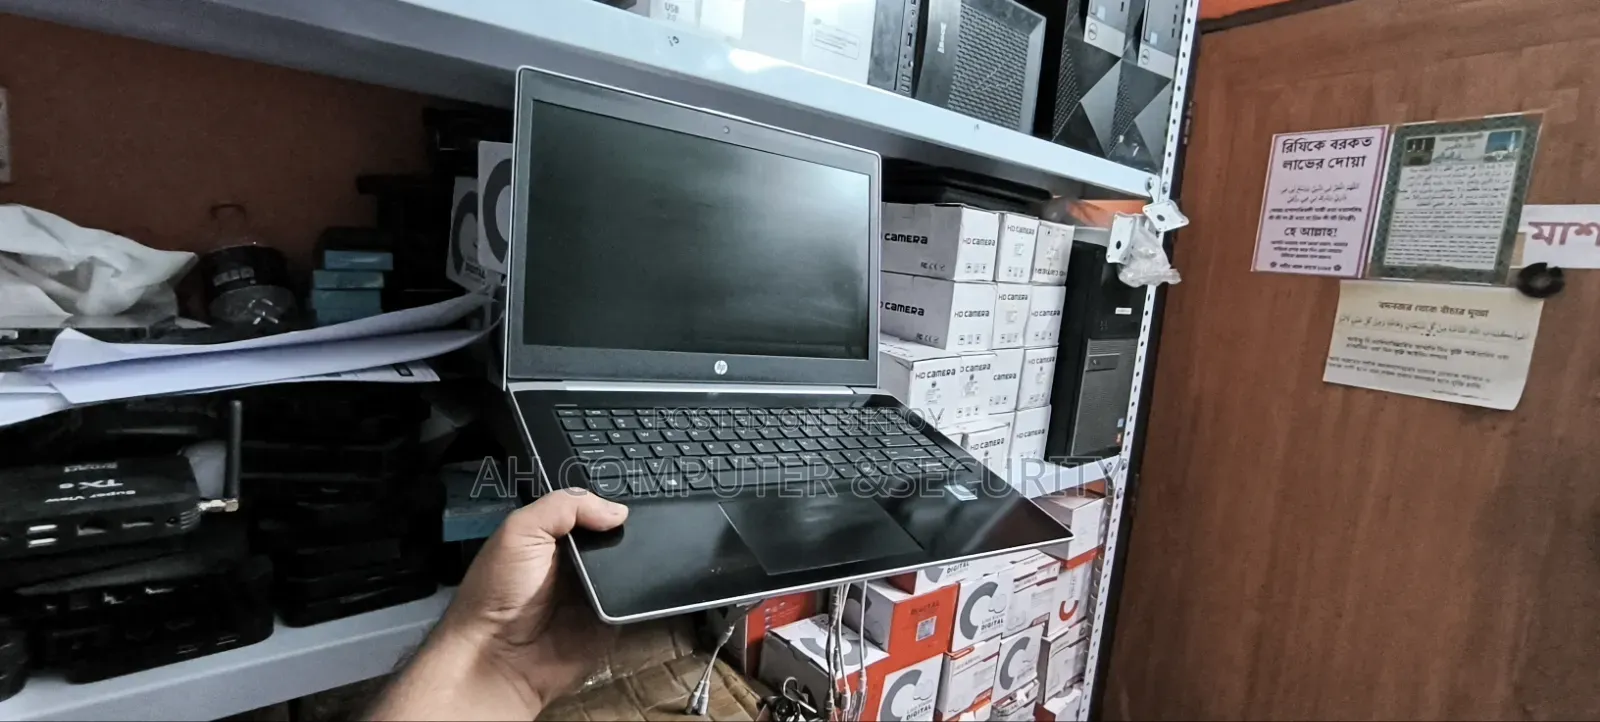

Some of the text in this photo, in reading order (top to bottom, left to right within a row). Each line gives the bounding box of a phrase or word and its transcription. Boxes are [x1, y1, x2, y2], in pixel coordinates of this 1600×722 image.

[664, 2, 679, 14] USB
[1281, 136, 1375, 153] রিযিকে বরকত
[1282, 158, 1326, 171] লাভের
[1284, 227, 1298, 237] হে
[906, 704, 932, 721] DIGITAL
